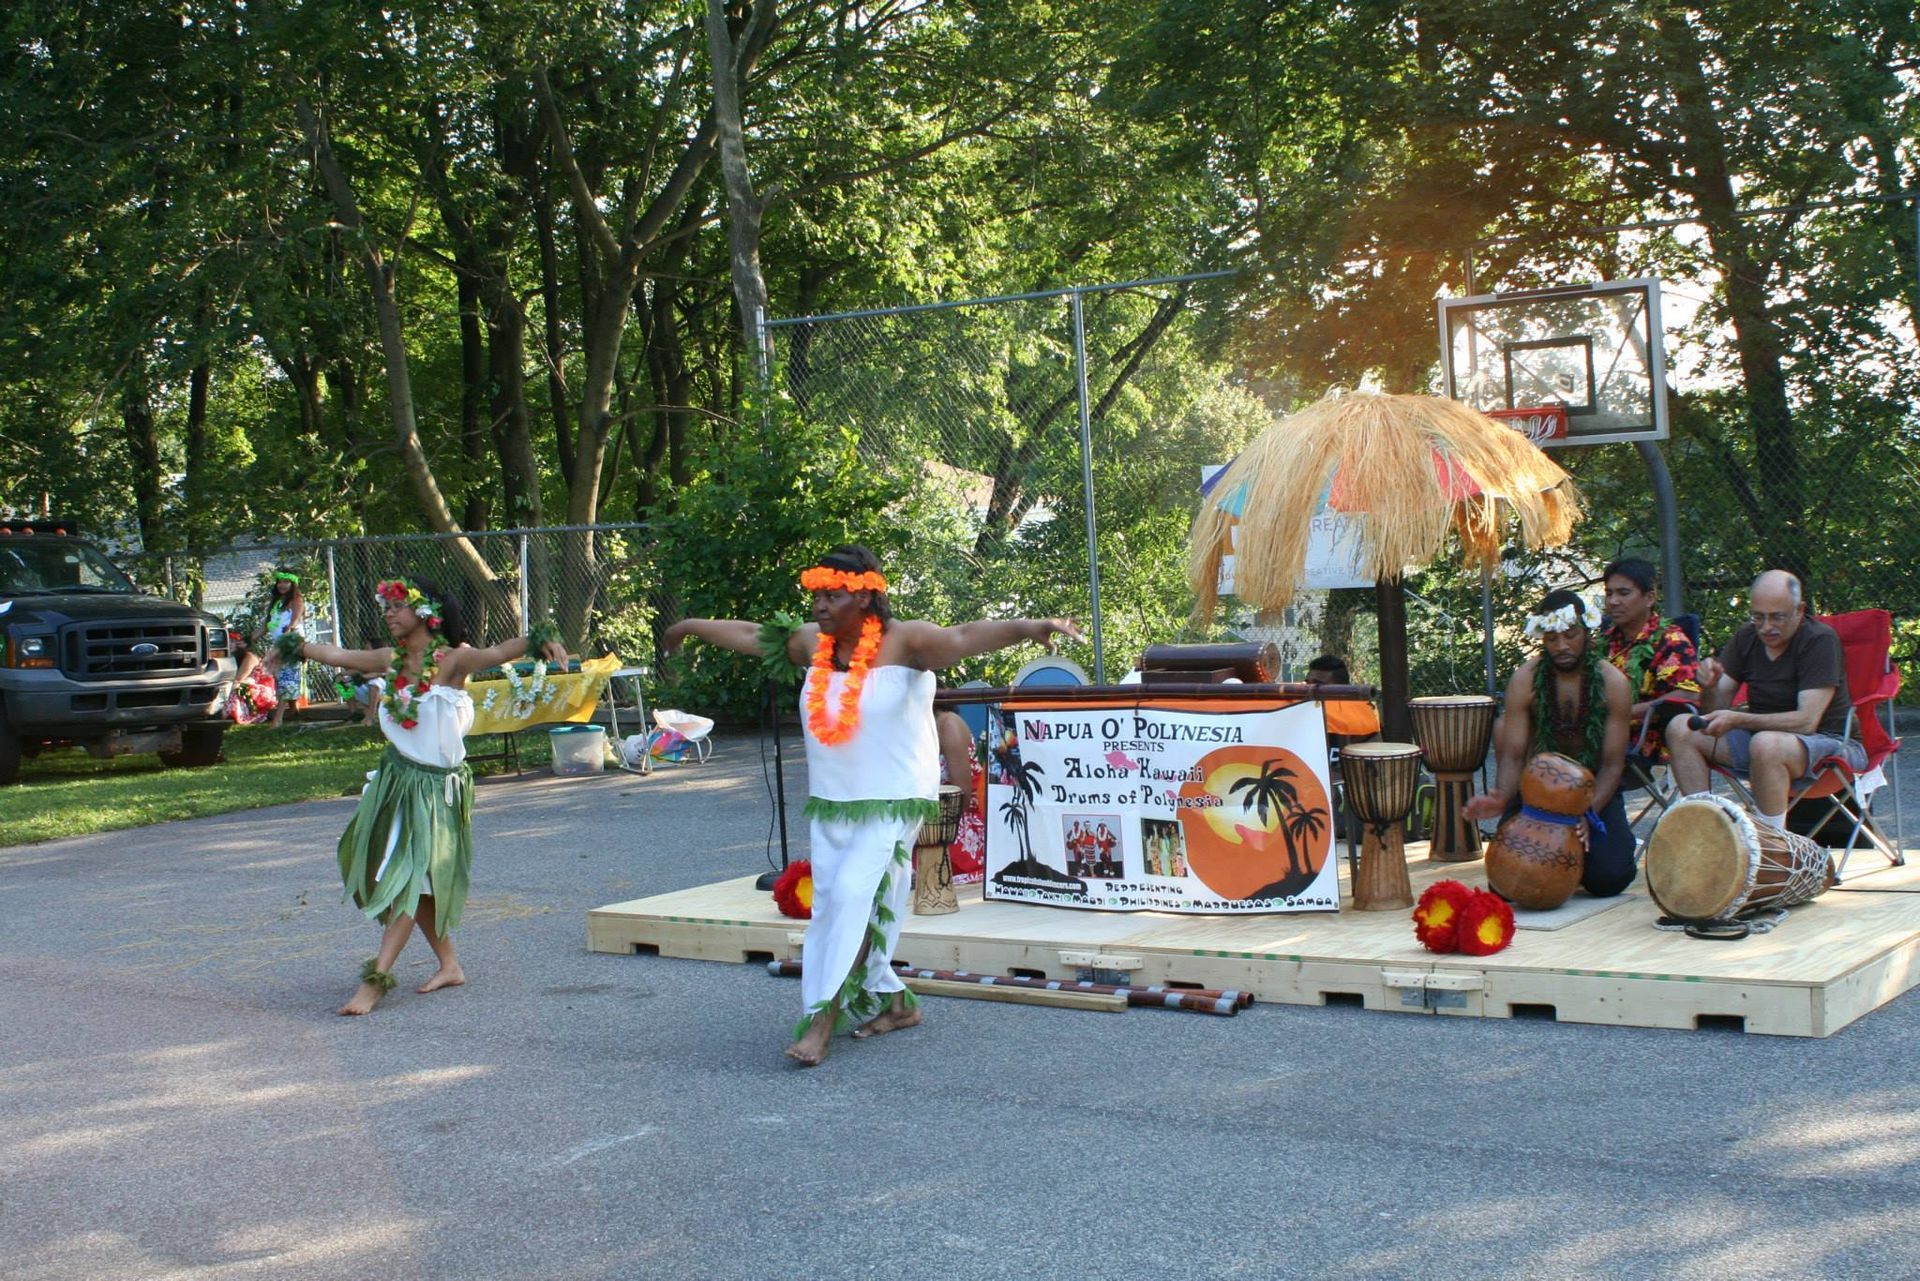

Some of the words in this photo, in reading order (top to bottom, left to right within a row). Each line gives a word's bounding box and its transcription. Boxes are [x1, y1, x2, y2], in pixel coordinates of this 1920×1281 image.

[1312, 518, 1346, 533] REA
[1304, 568, 1345, 576] REATIVE
[1024, 719, 1093, 740] NAPUA
[1101, 717, 1124, 740] O'
[1133, 716, 1244, 743] POLYNESIA
[1104, 741, 1165, 752] PRESENTS
[1064, 757, 1129, 779] Aloha
[1137, 757, 1204, 782] Hawaii
[1051, 785, 1111, 804] Drums
[1117, 789, 1137, 805] of
[1141, 785, 1224, 811] Polynesia
[1192, 898, 1272, 908] MARQUESAS
[1287, 895, 1332, 907] SAMOA
